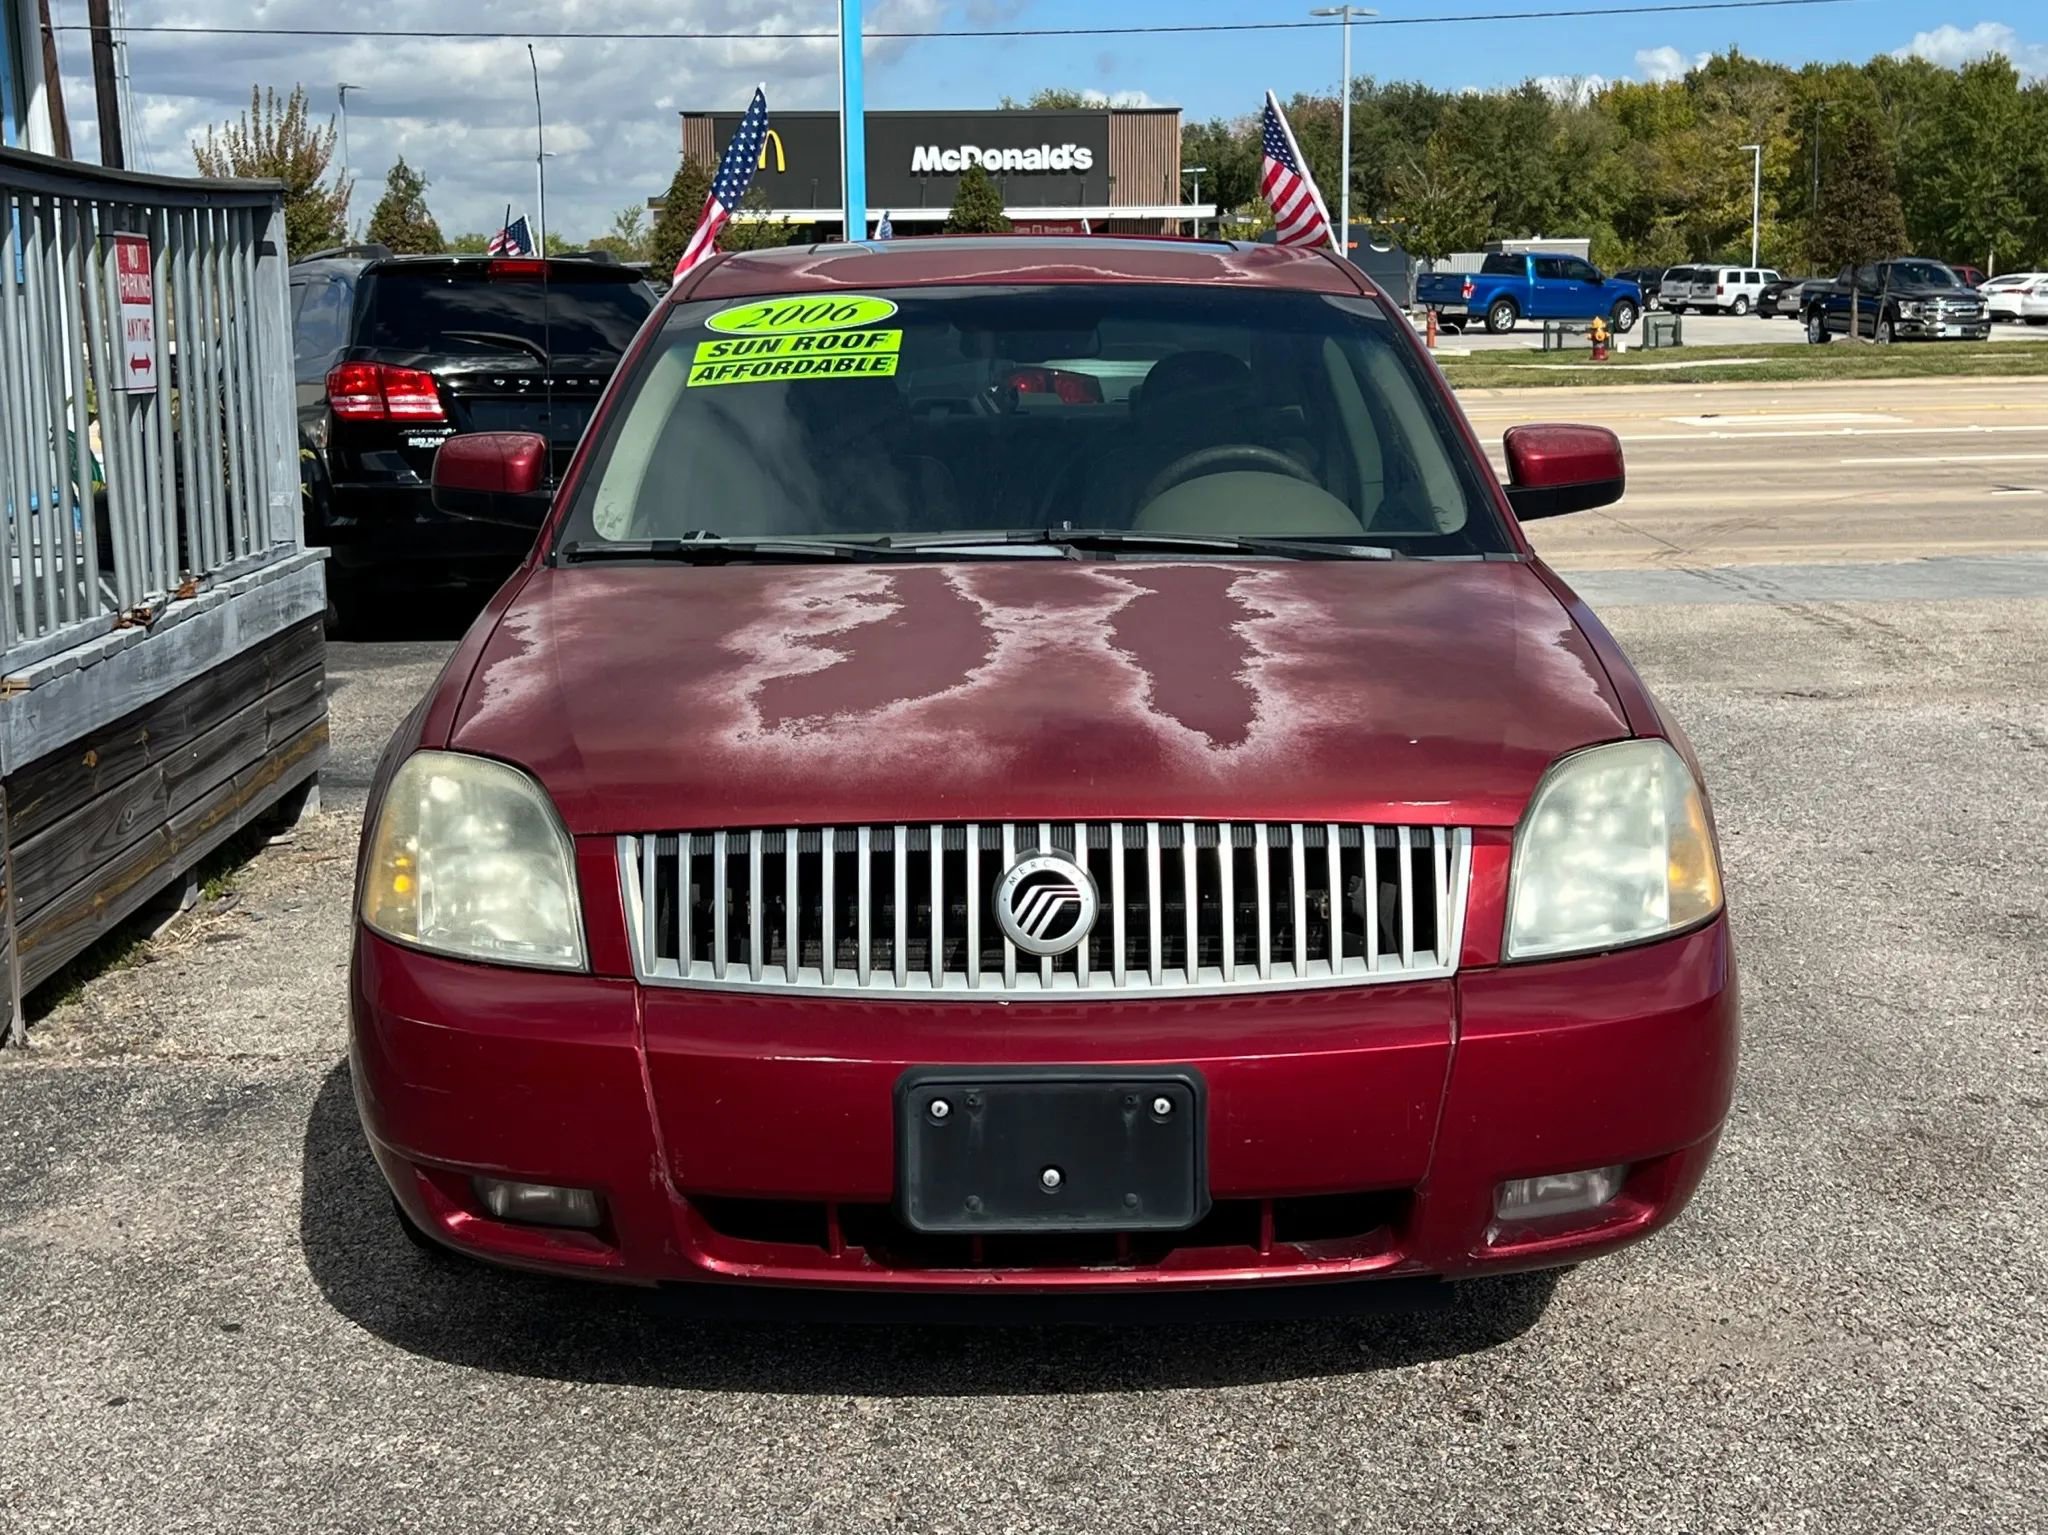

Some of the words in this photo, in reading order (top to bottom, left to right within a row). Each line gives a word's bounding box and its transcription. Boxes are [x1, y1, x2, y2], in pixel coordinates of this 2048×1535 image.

[911, 142, 1093, 172] McDonald's
[127, 244, 139, 269] NO
[120, 273, 151, 298] PARKING
[735, 300, 870, 329] 2006
[127, 318, 151, 342] ANYTIME
[708, 338, 784, 358] SUN
[790, 332, 891, 352] ROOF
[692, 356, 893, 382] AFFORDABLE
[1008, 859, 1084, 885] MERC
